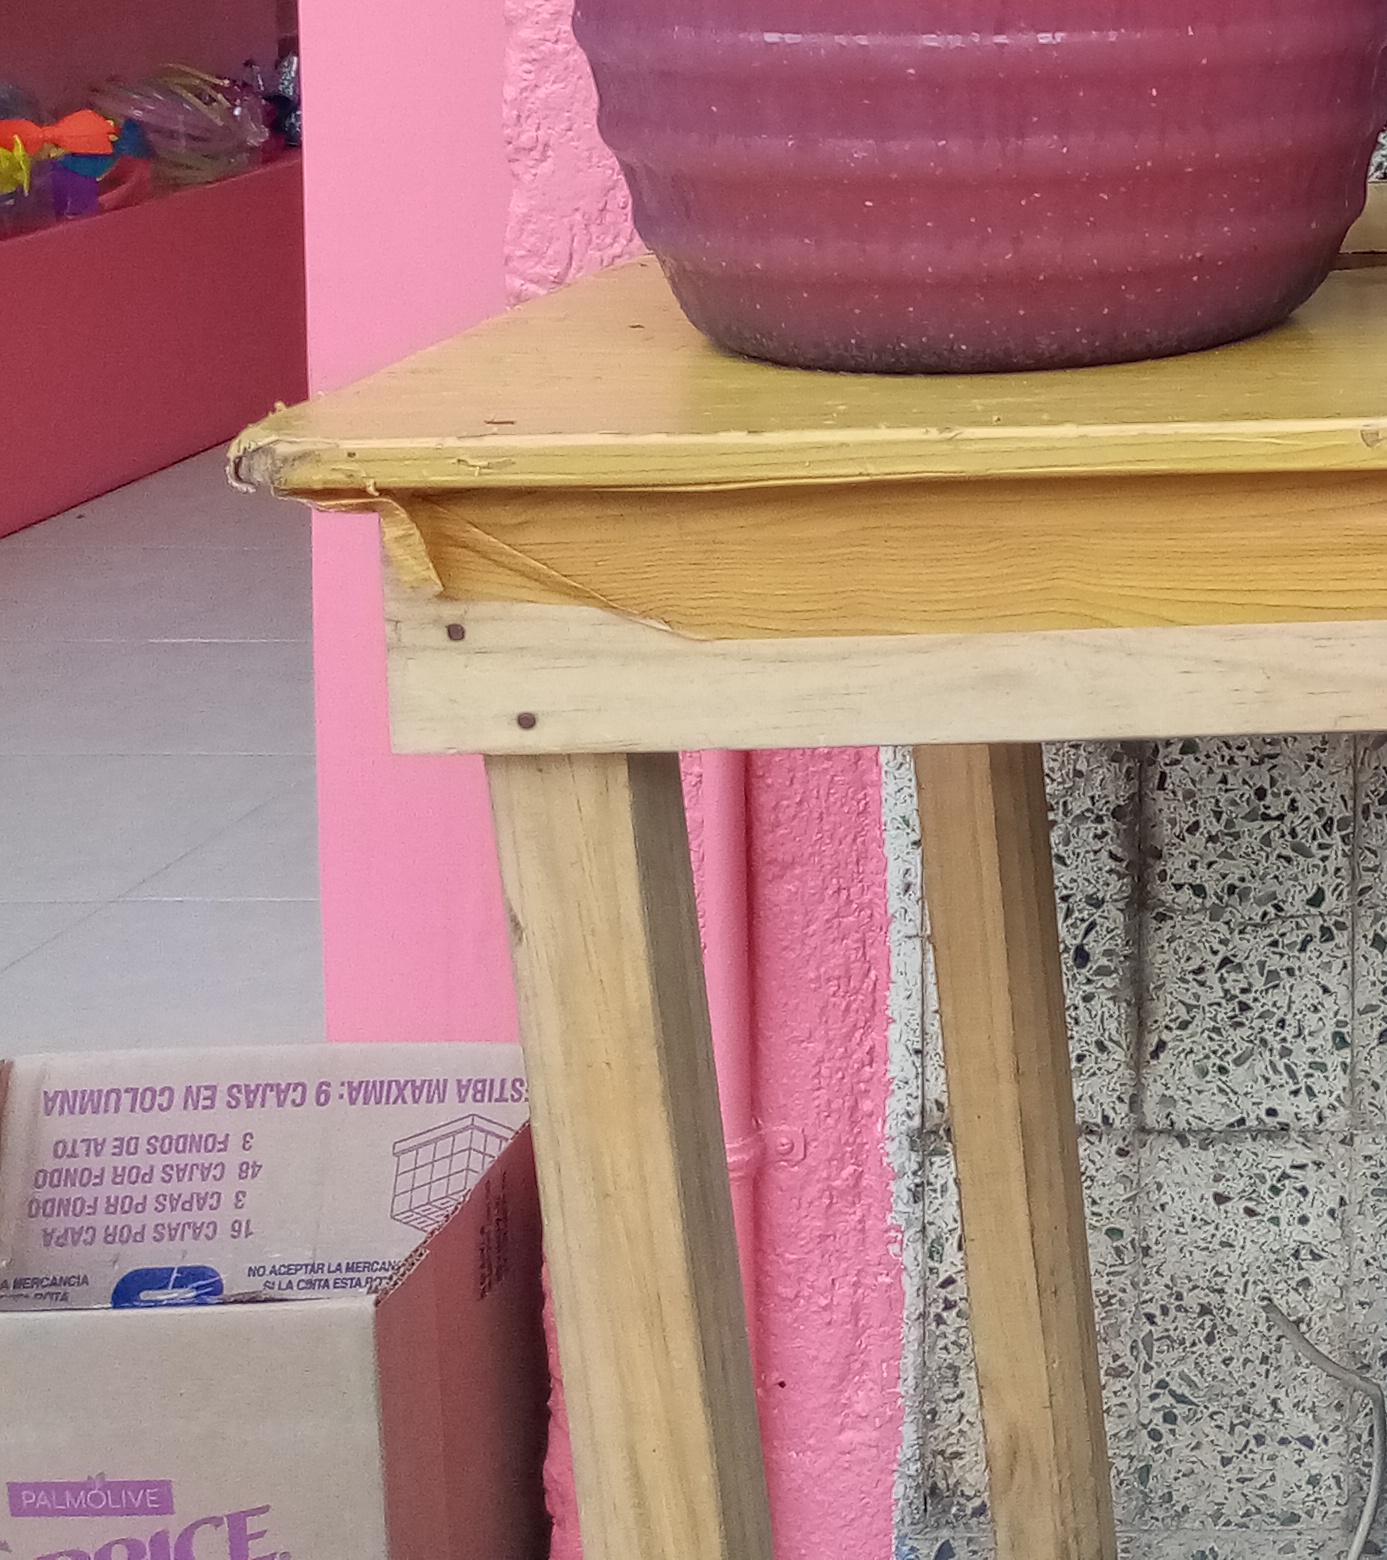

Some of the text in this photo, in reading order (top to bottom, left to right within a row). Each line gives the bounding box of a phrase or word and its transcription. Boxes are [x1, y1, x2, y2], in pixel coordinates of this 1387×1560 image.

[43, 1077, 530, 1116] STIBA MAXIMA: 9 CAJAS EN COLUMNA
[52, 1132, 255, 1160] 3 FONDOS DE ALTO
[33, 1160, 263, 1189] 48 CAJAS POR FONDO
[26, 1190, 247, 1218] 3 CAPAS POR FONDO
[41, 1219, 255, 1247] 16 CAJAS POR CAPA
[12, 1274, 90, 1290] MERCANCIA
[247, 1260, 398, 1278] NO ACEPTAR LA MERCAN
[278, 1279, 293, 1291] LA
[332, 1277, 361, 1289] ESTA
[20, 1488, 161, 1511] PALMOLIVE
